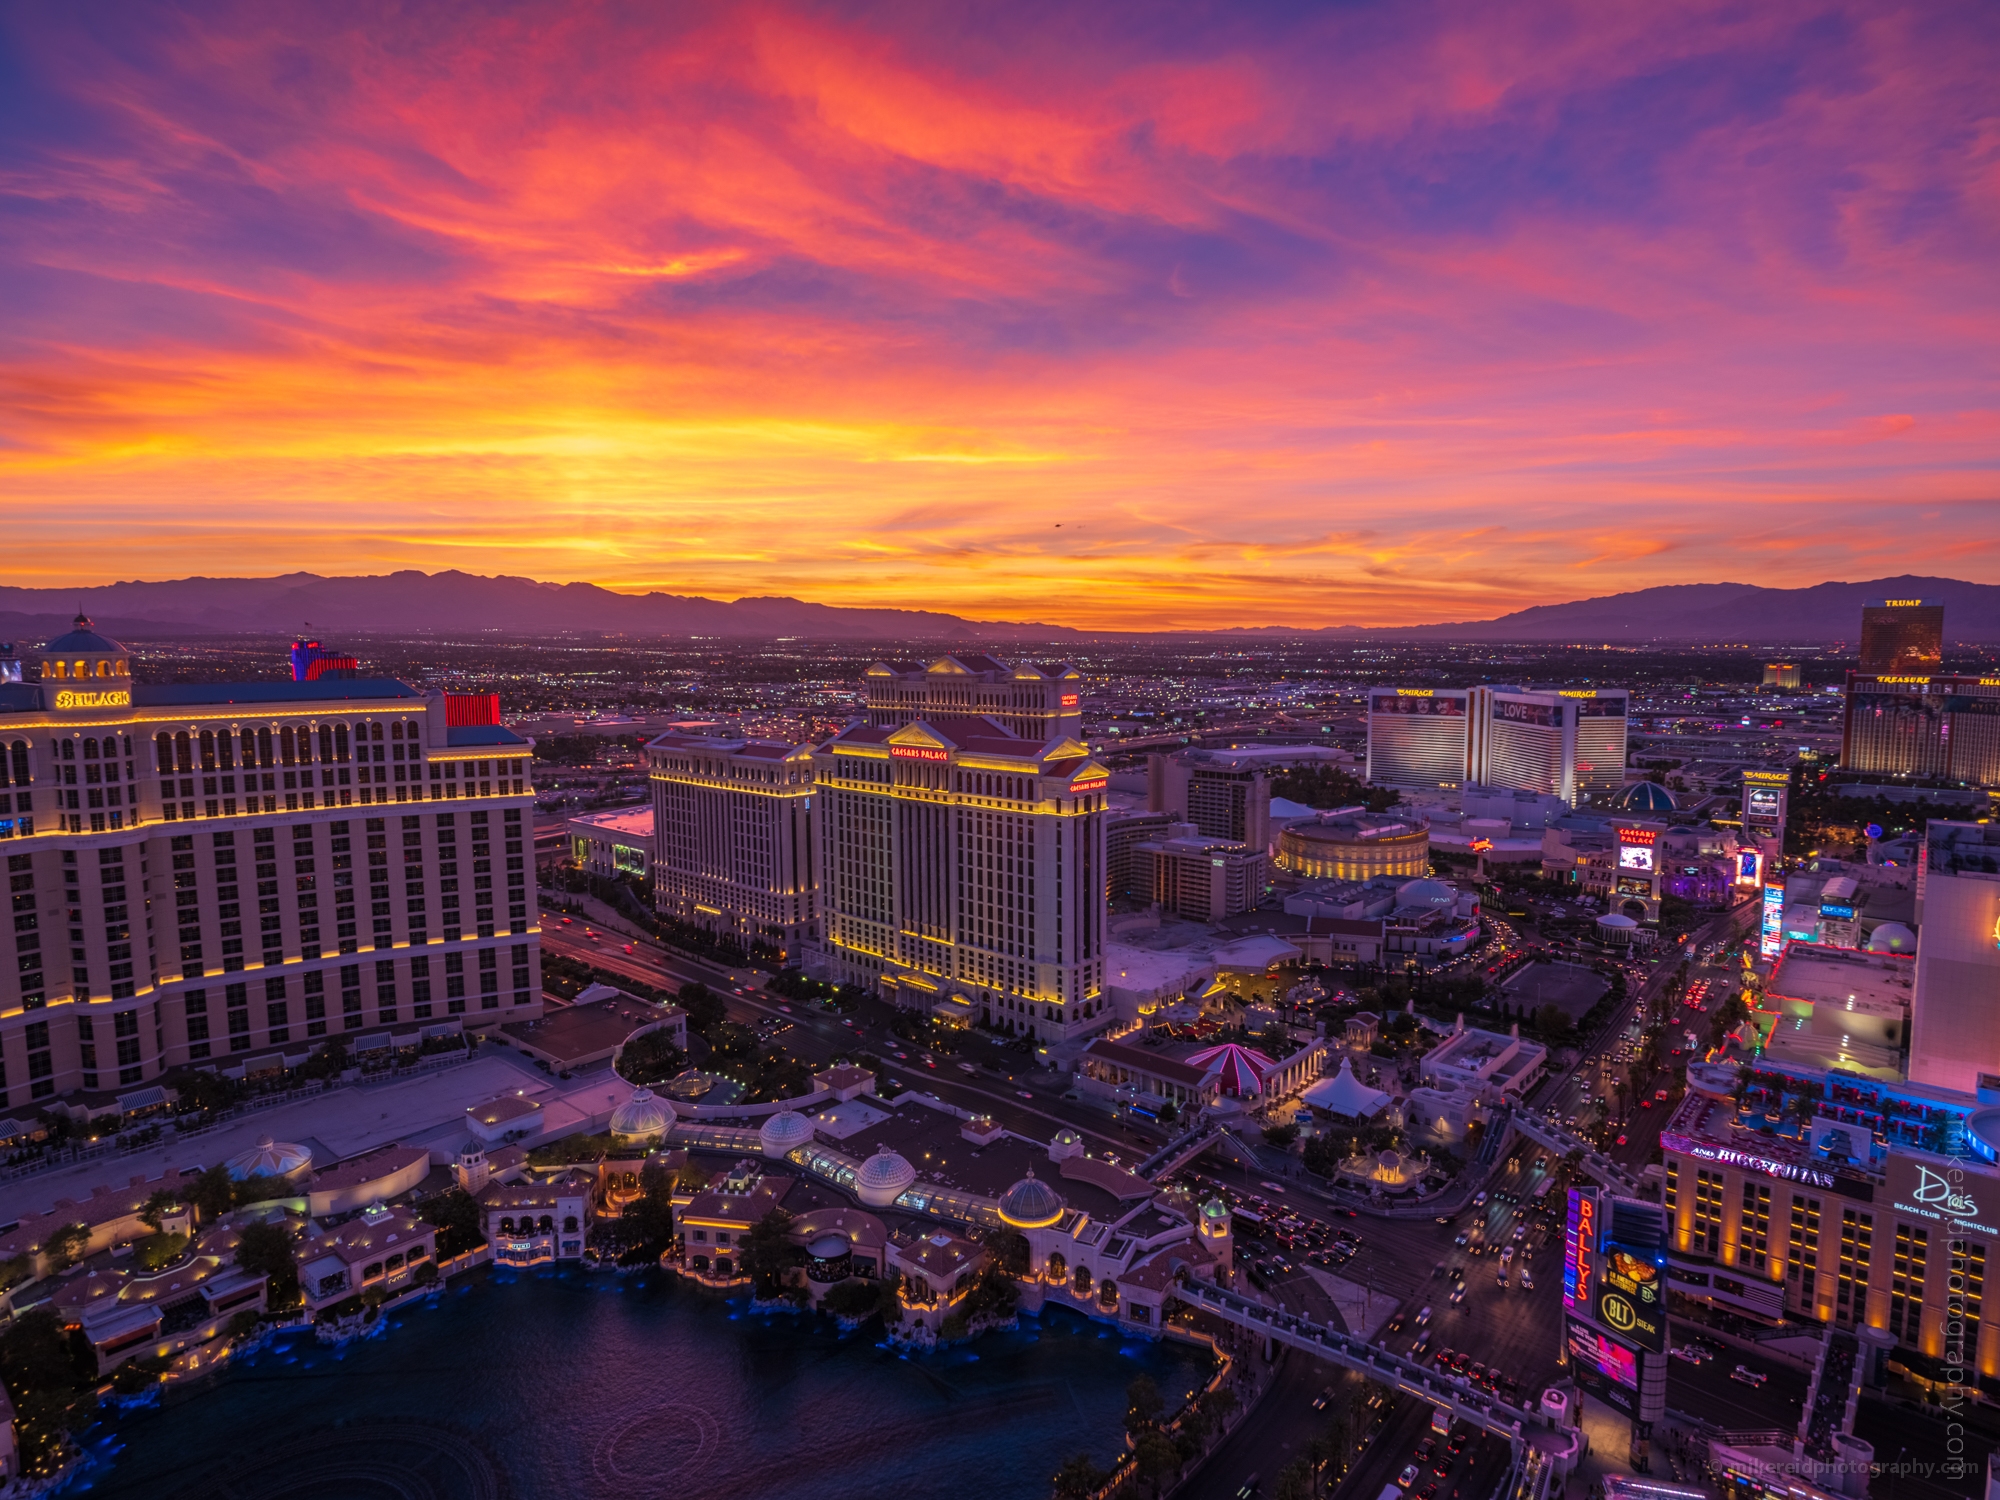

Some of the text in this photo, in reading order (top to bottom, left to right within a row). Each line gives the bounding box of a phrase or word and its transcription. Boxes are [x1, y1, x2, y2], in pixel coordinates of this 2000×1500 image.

[1877, 676, 1930, 684] TREASURE
[1401, 689, 1434, 697] MIRAGE
[1563, 690, 1597, 698] MIRAGE
[1504, 703, 1527, 719] LOVE
[891, 747, 948, 761] CAESARS PALACE
[1747, 772, 1789, 781] MIRAGE
[1070, 780, 1107, 793] CAESARS PALACE
[1619, 829, 1656, 838] CAESARS
[1620, 836, 1655, 845] PALACE
[1691, 1147, 1835, 1188] AND BIGGER WINS
[1894, 1202, 1998, 1235] BEACH CLUB NIGHTCLUB
[1609, 1299, 1656, 1335] BLT STEAK
